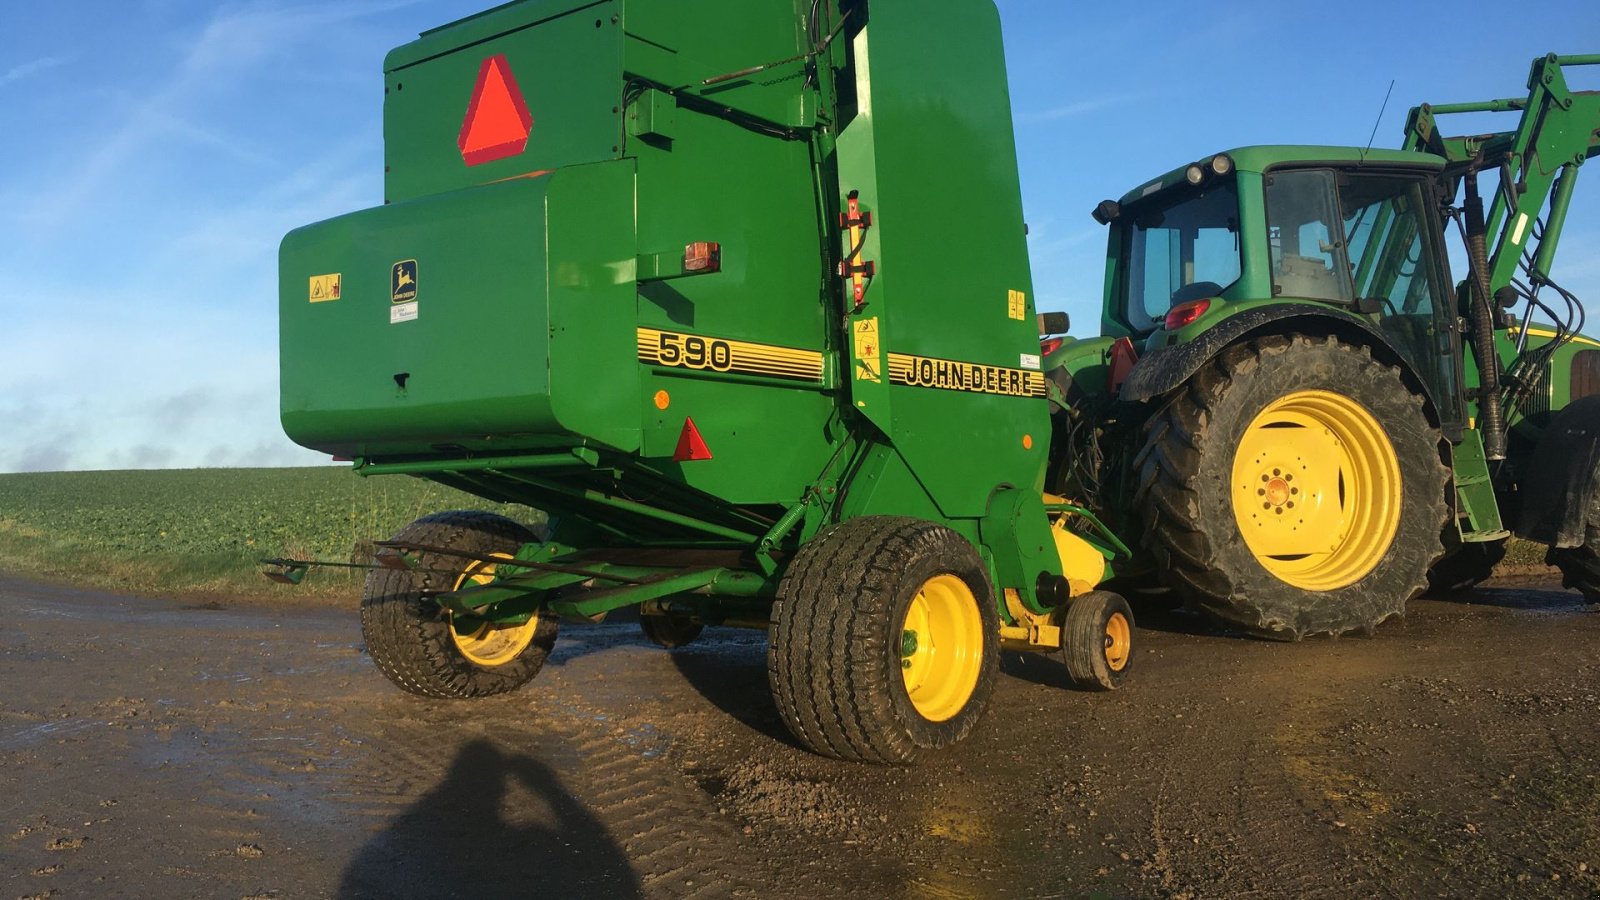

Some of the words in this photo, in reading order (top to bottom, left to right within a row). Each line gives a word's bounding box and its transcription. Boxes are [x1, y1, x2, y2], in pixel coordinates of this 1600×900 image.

[659, 333, 731, 369] 590
[906, 358, 964, 388] JOHN
[971, 365, 1031, 394] DEERE
